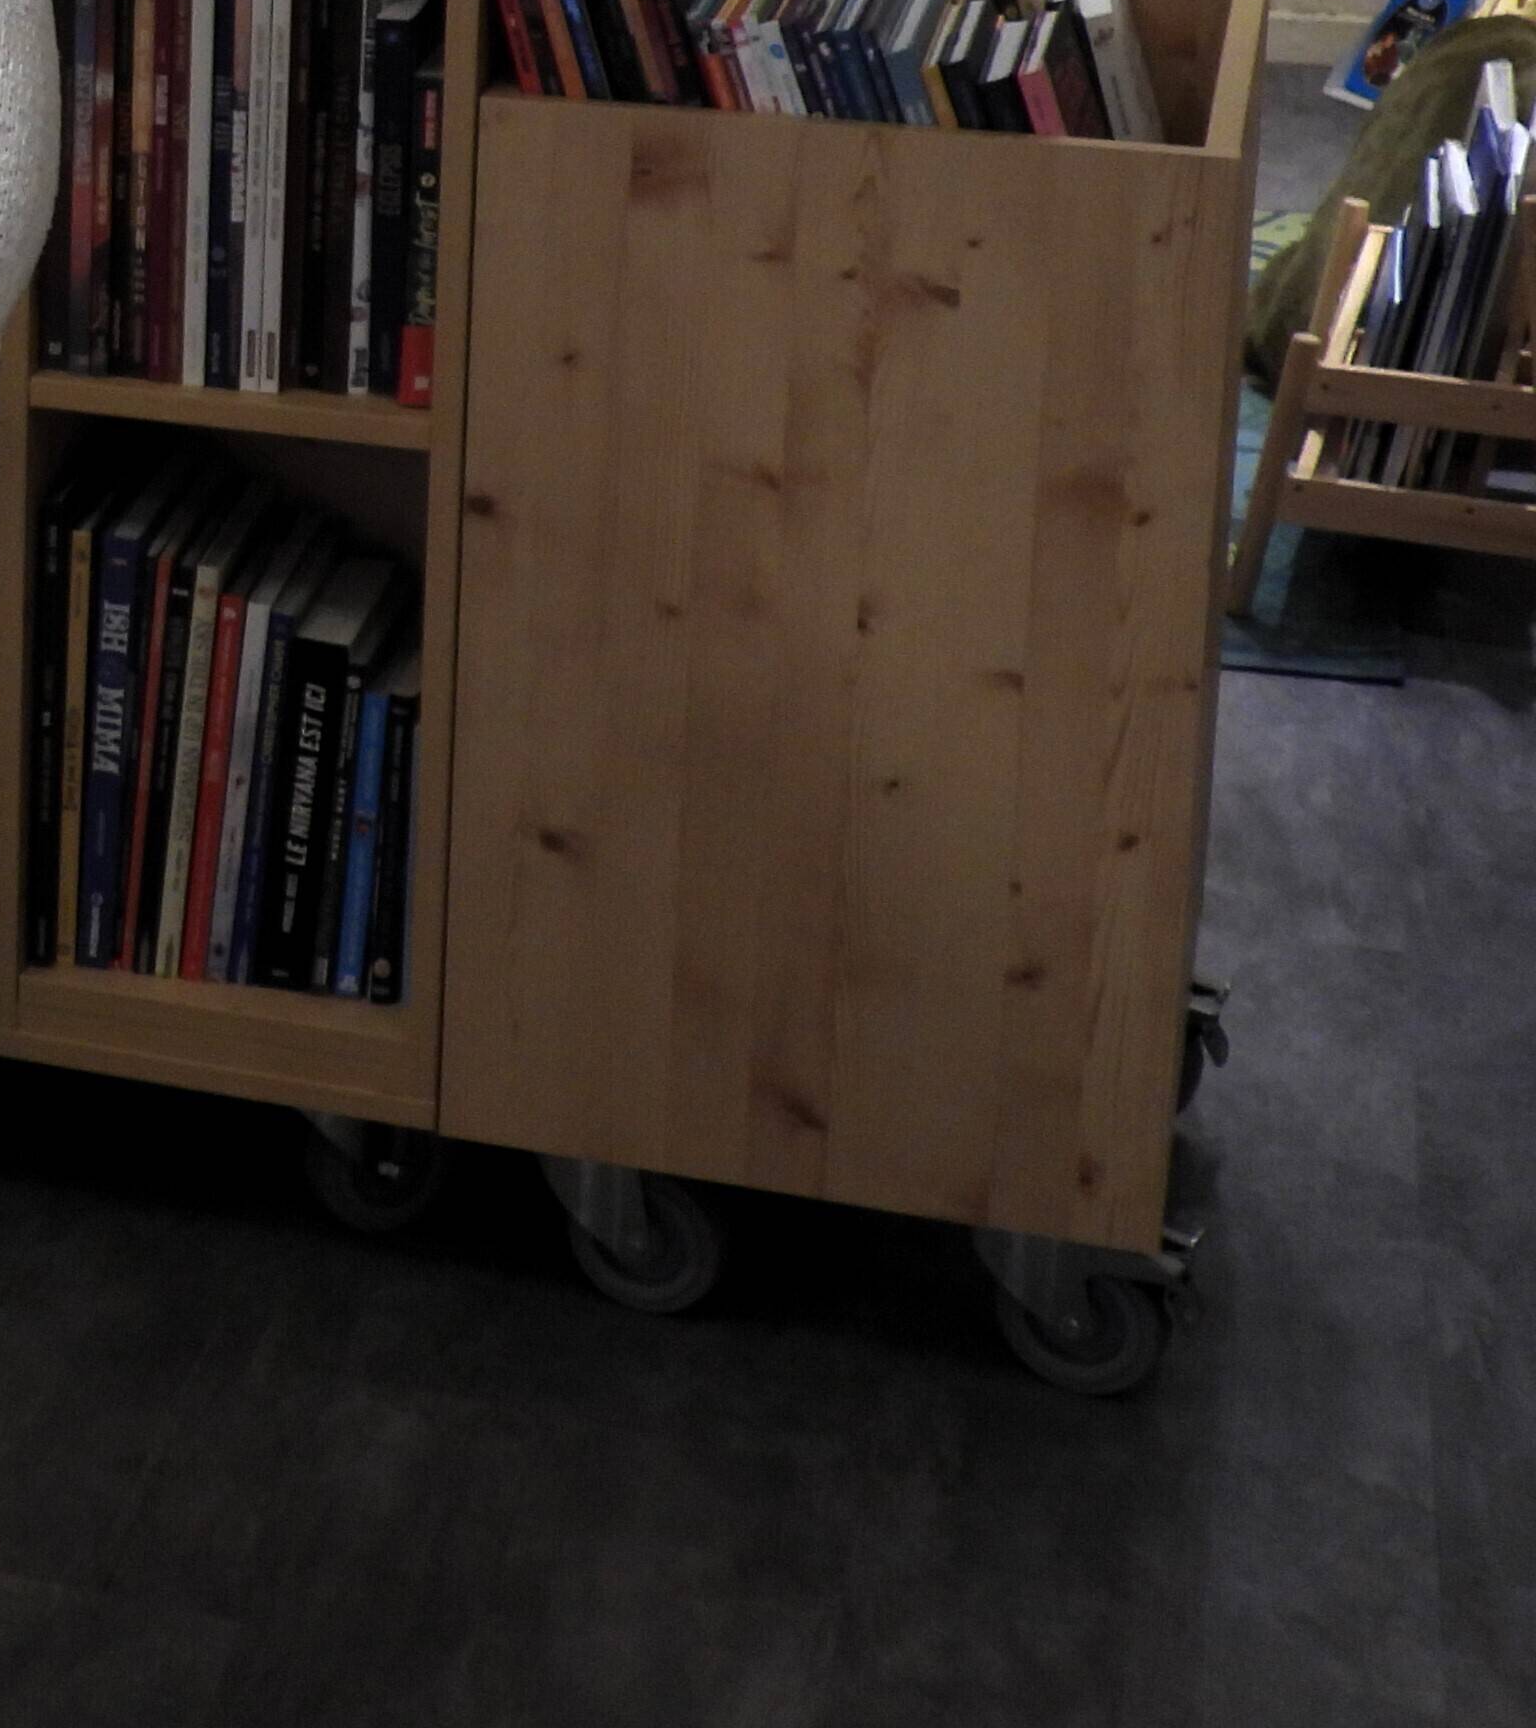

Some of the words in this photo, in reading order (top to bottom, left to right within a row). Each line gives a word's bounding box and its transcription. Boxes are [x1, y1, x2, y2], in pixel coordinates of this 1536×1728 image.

[301, 681, 327, 712] ICI
[298, 714, 326, 752] EST
[287, 754, 320, 839] NIRVANA
[285, 840, 310, 867] LE
